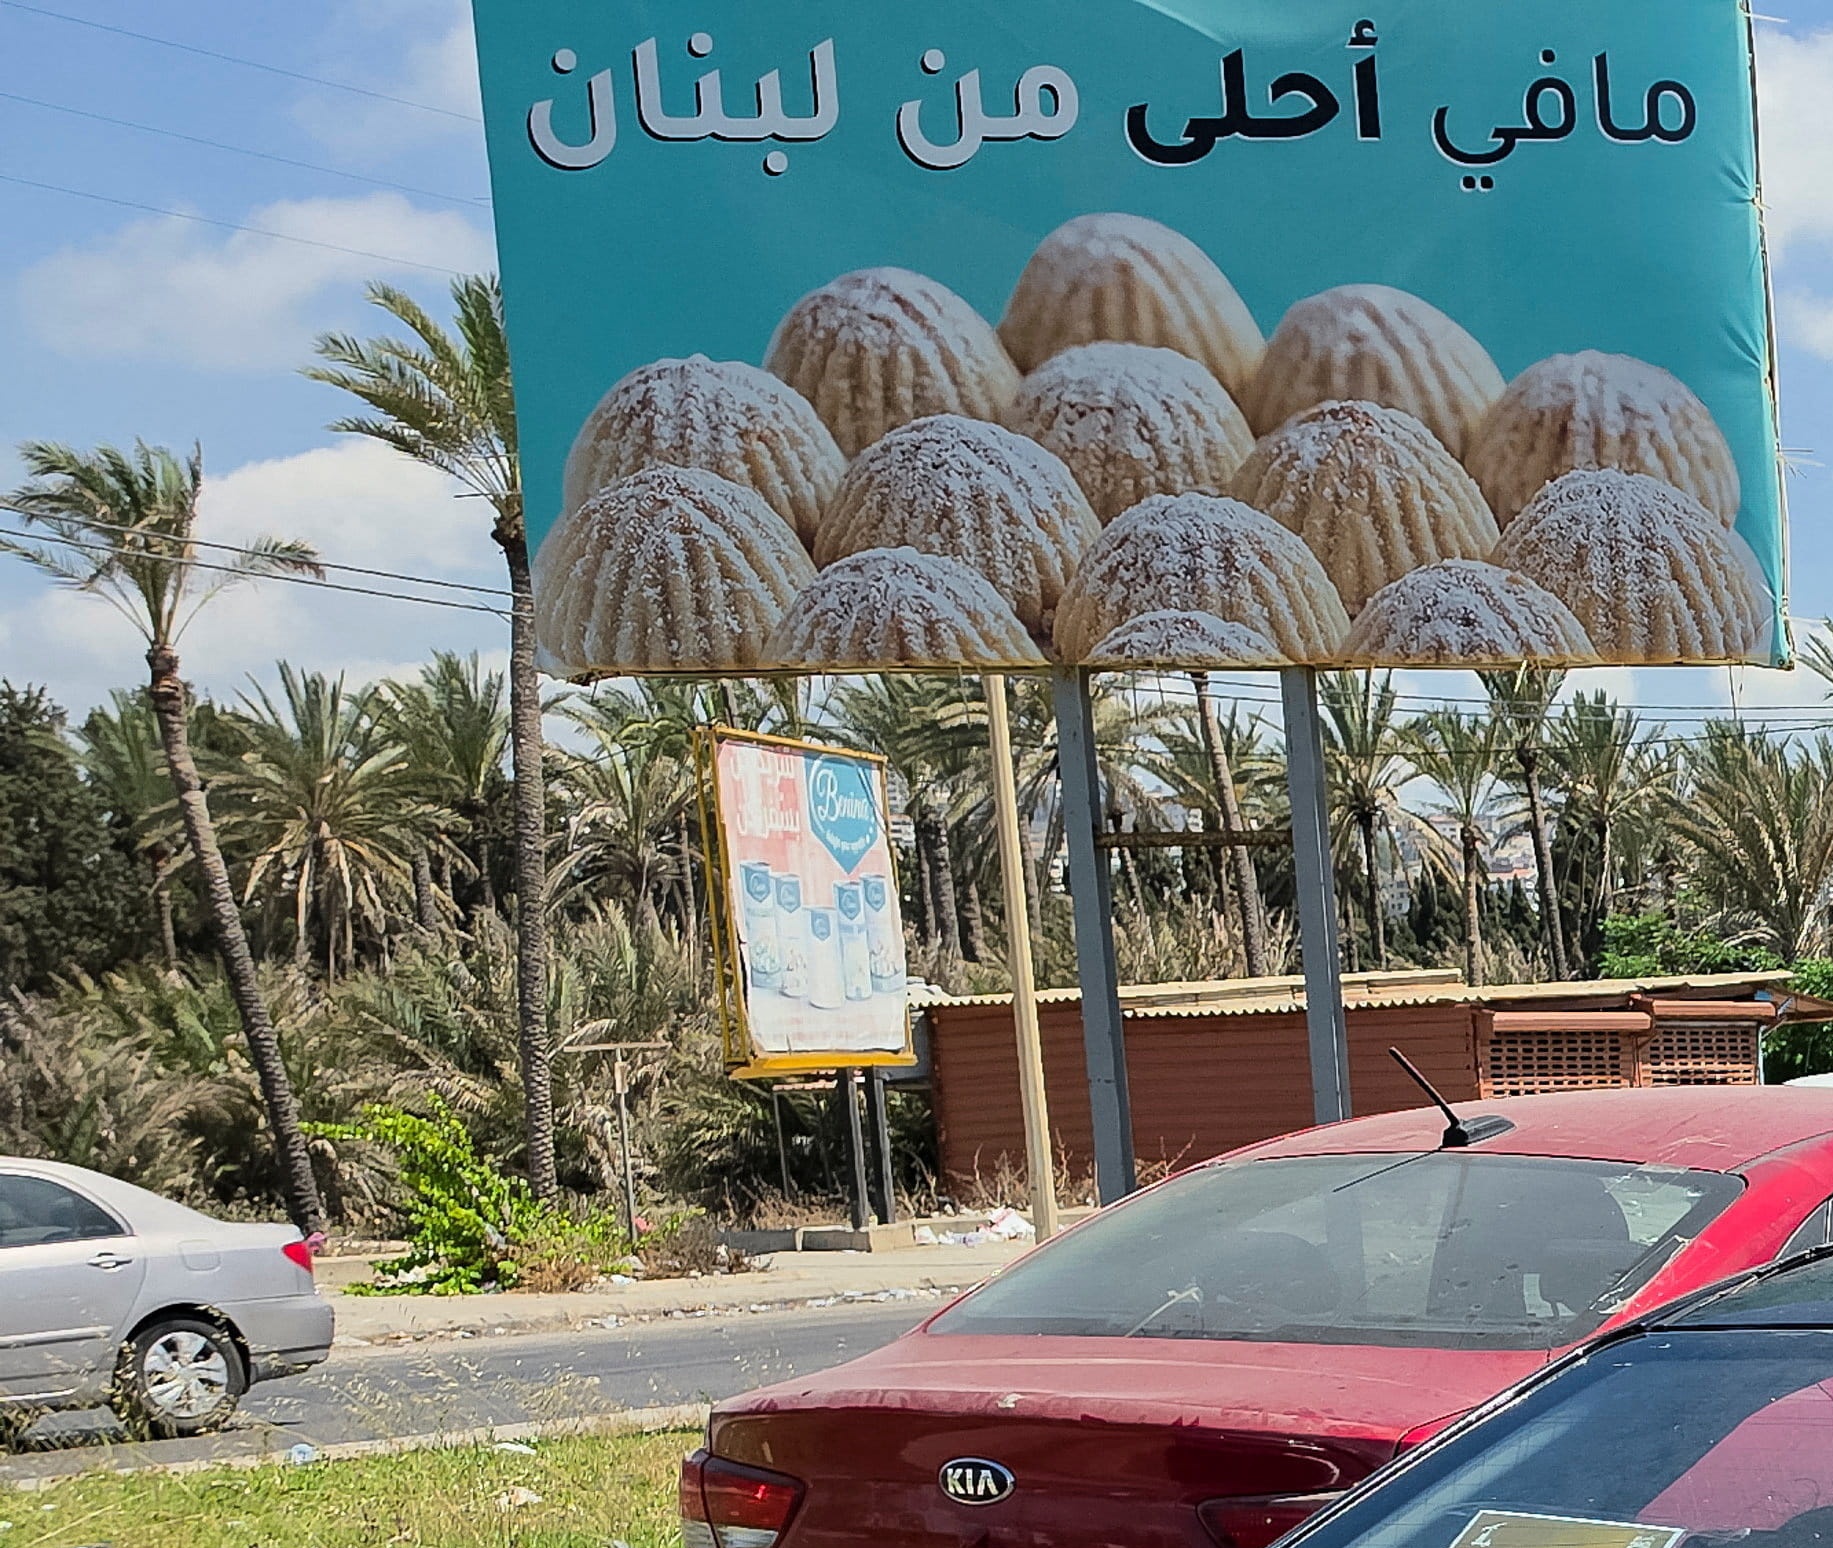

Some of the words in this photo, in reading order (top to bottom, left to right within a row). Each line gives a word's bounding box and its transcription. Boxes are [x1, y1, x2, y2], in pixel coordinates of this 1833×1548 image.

[526, 32, 839, 177] لبنان
[896, 46, 1080, 173] من
[1126, 18, 1383, 167] أحلى
[1433, 48, 1696, 193] مافي
[817, 768, 870, 821] Benina
[946, 1467, 999, 1496] KIA
